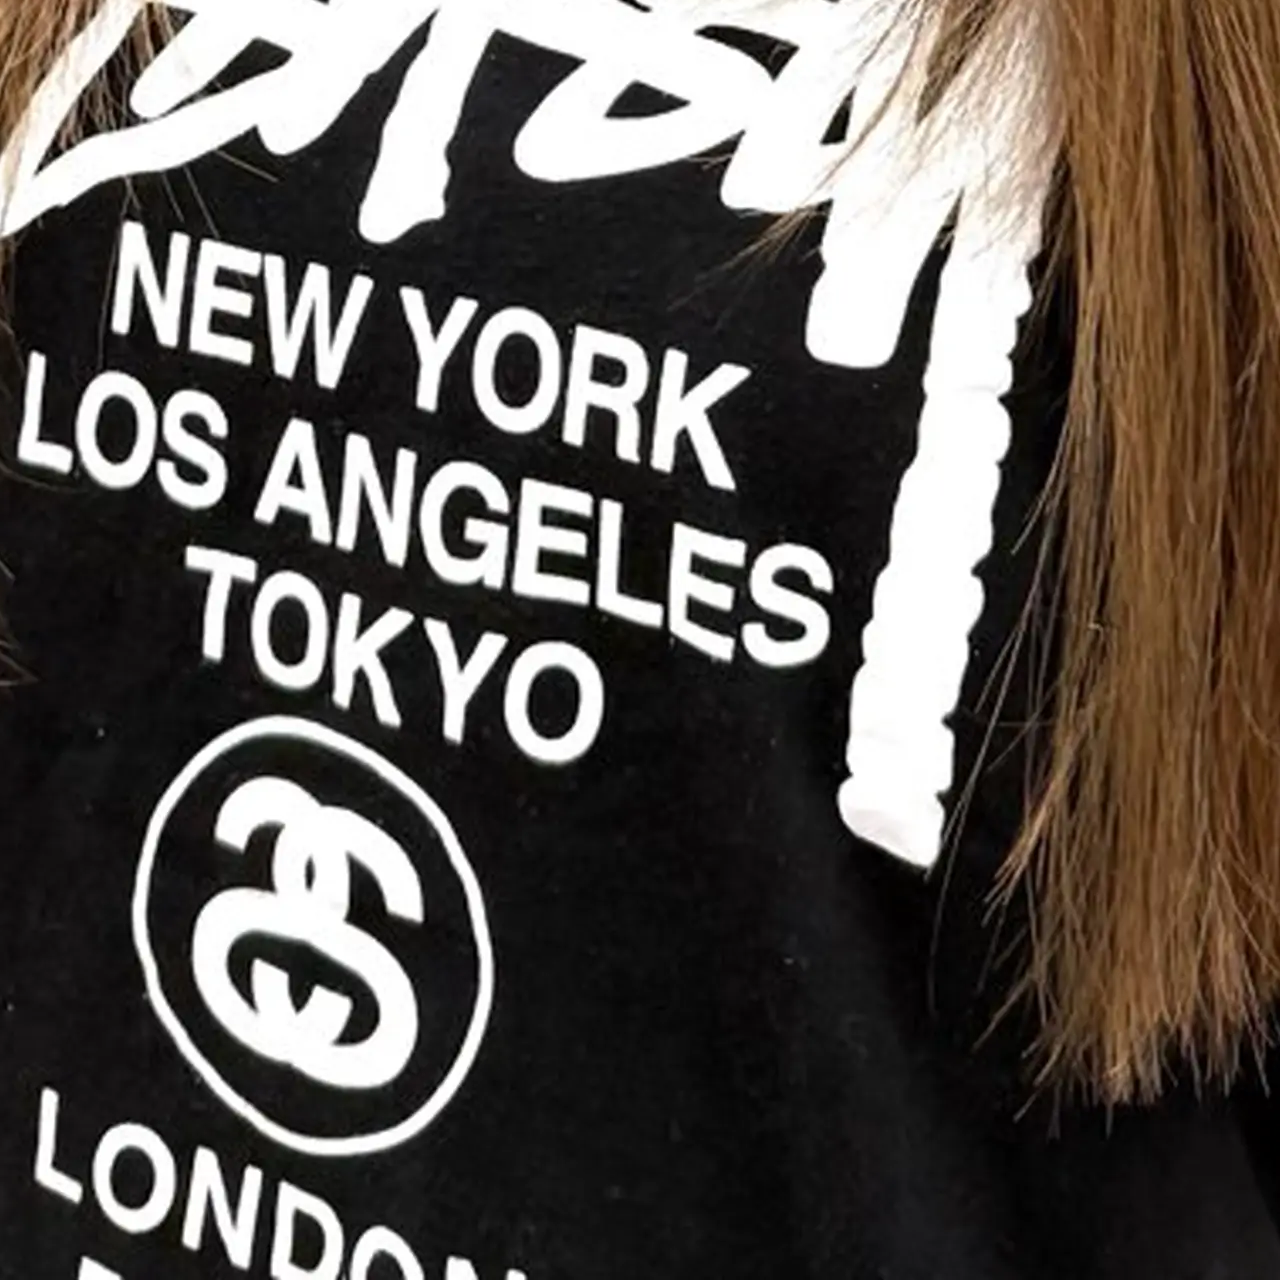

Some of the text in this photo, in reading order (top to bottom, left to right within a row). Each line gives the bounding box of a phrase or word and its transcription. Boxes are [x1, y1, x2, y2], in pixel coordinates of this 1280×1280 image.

[110, 219, 752, 492] NEW YORK
[16, 350, 835, 668] LOS ANGELES
[184, 544, 605, 765] TOKYO
